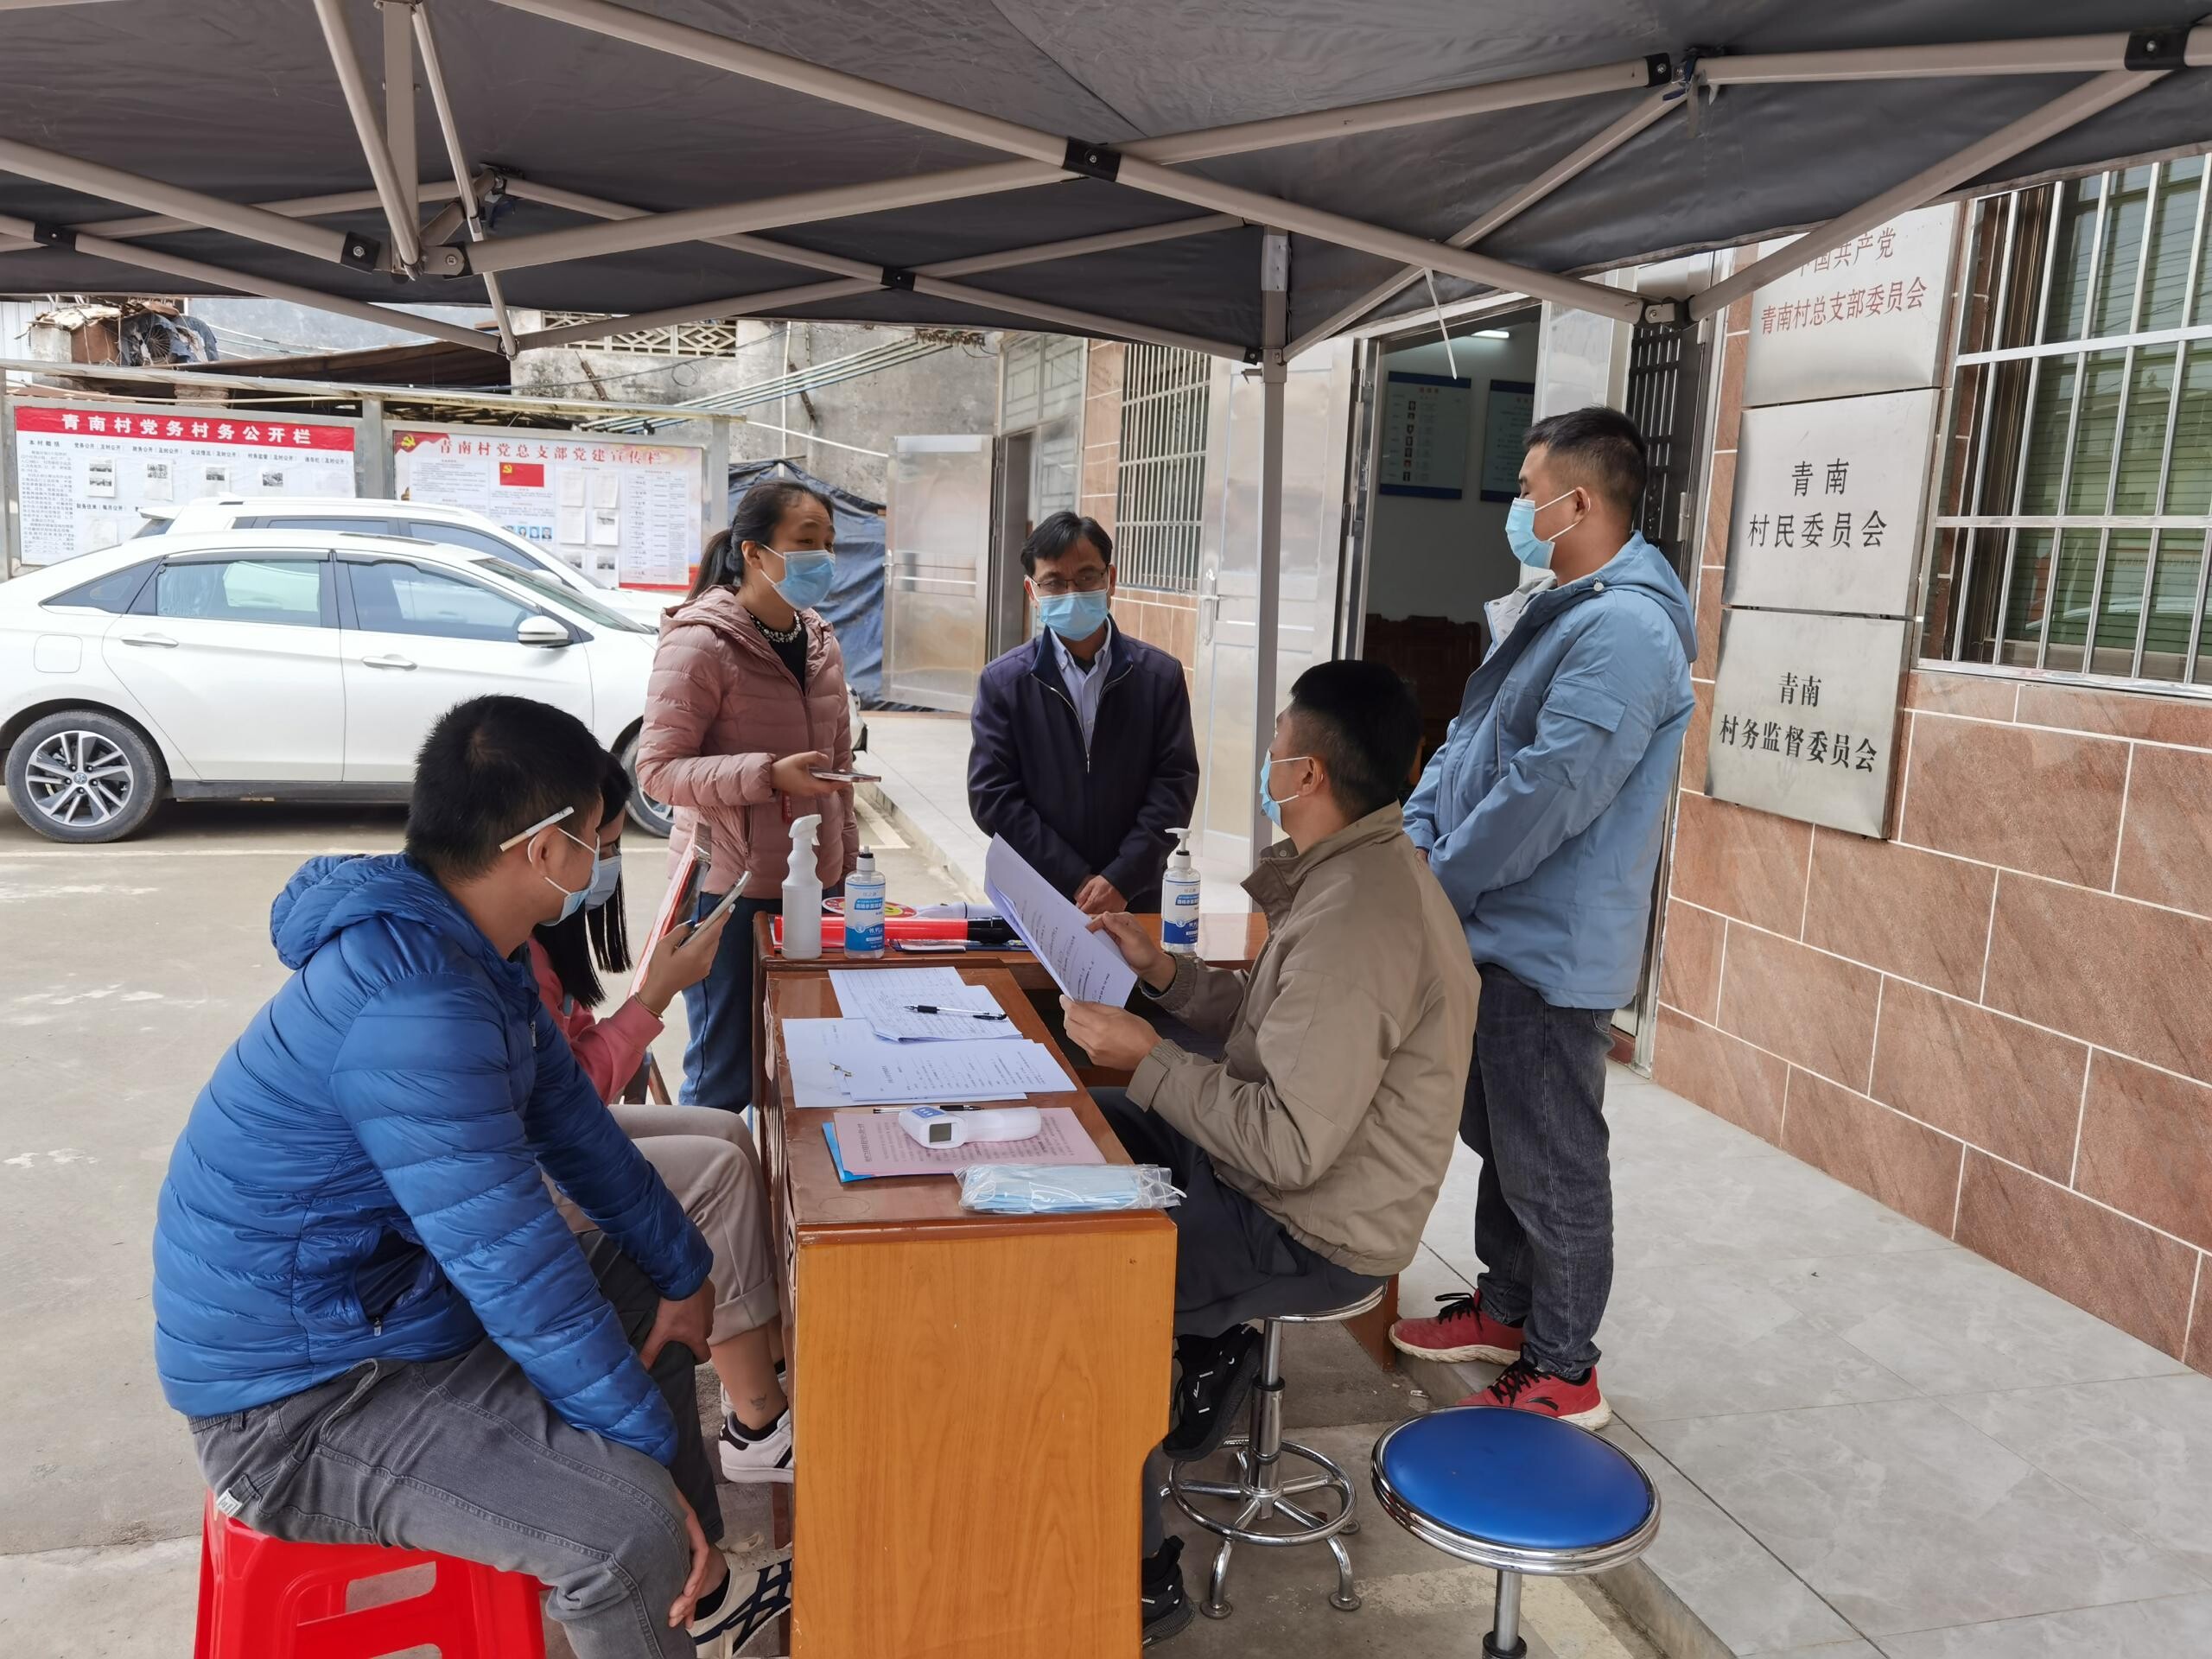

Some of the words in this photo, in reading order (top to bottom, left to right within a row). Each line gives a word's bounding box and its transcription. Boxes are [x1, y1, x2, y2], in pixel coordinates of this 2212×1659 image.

[1760, 276, 1928, 335] 青南村总支部委员会
[61, 413, 312, 445] 青南村党务村务公开栏
[439, 440, 663, 466] 青南村党总支部党建宣传栏
[1791, 458, 1849, 497] 青南
[1748, 510, 1888, 549] 村民委员会
[1777, 671, 1822, 707] 青南
[1719, 715, 1878, 772] 村务监督委员会
